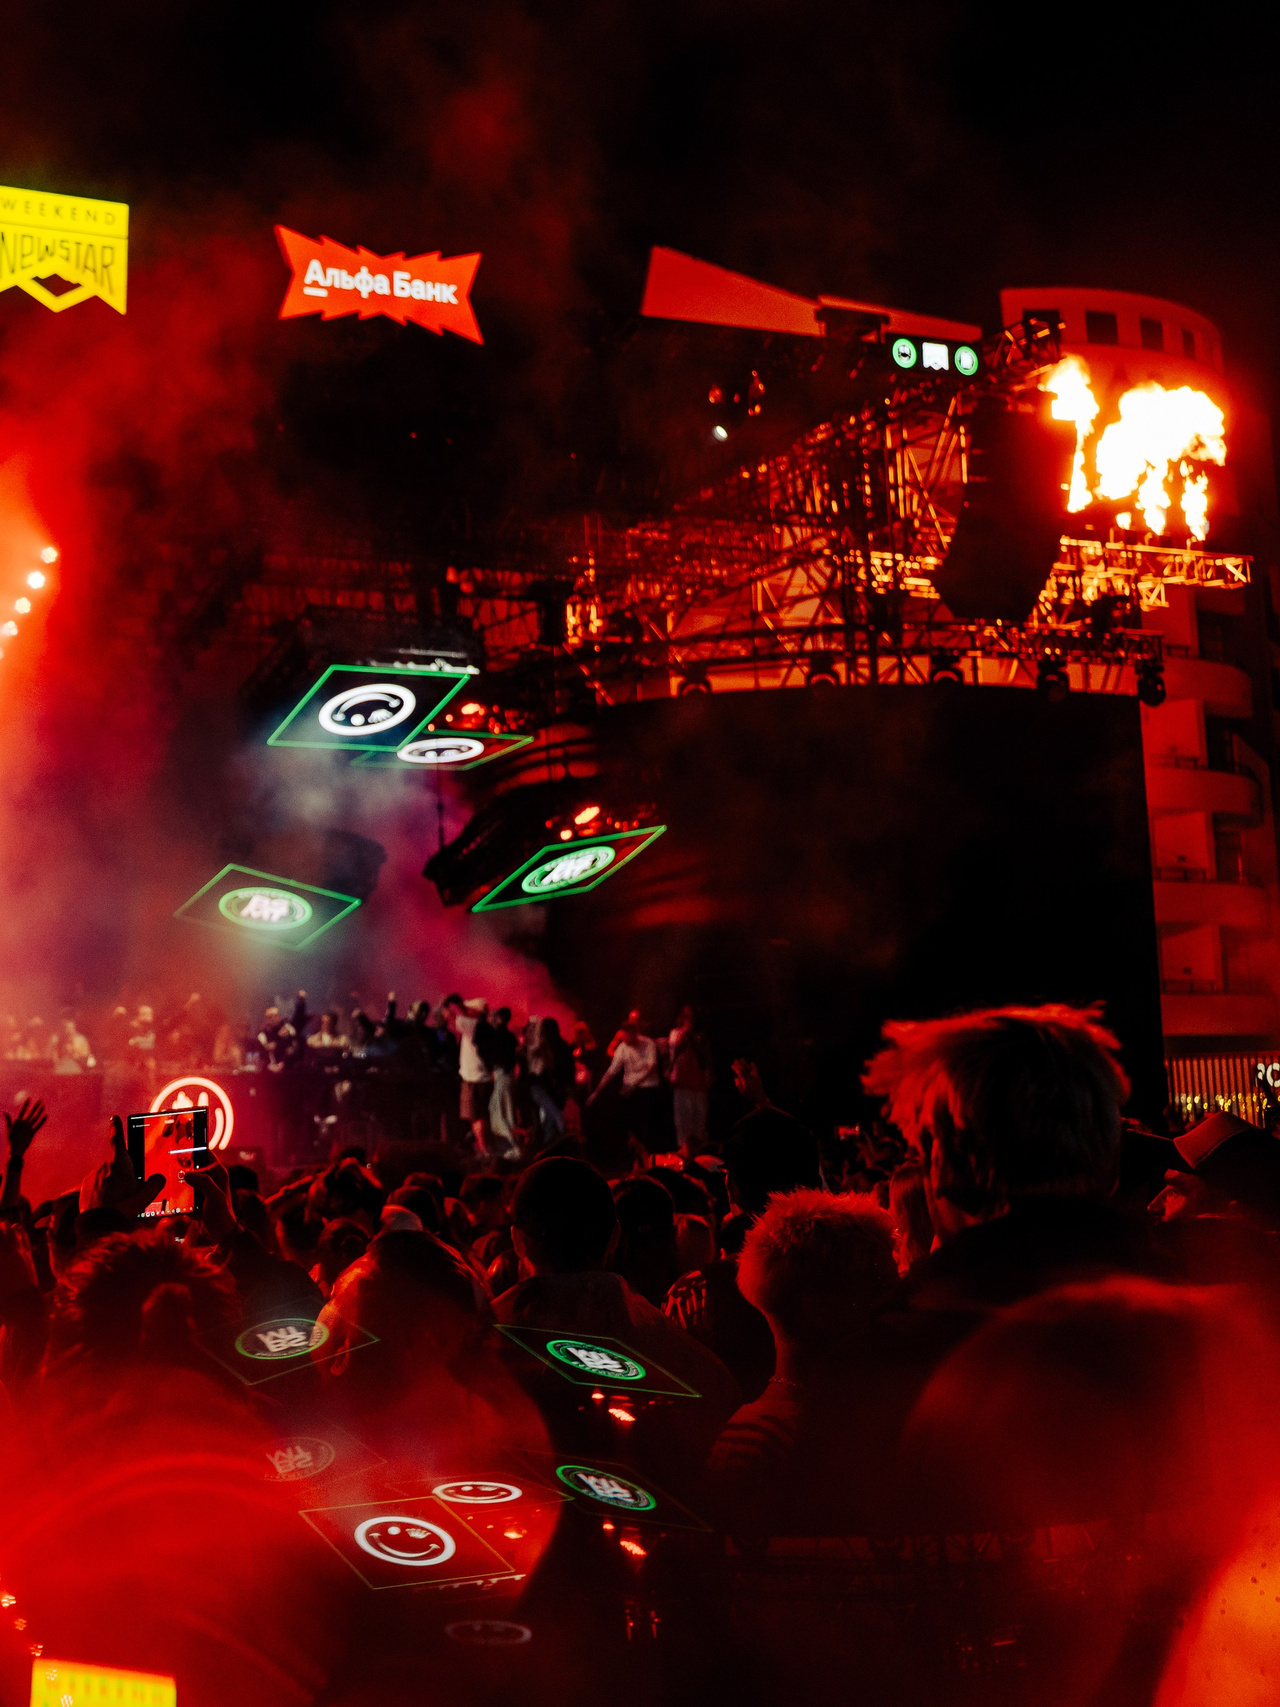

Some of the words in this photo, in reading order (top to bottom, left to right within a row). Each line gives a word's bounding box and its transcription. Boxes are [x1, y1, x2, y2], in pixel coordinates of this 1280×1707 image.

[0, 198, 117, 226] WEEKEND
[304, 258, 391, 299] Альфа
[393, 270, 459, 305] Банк
